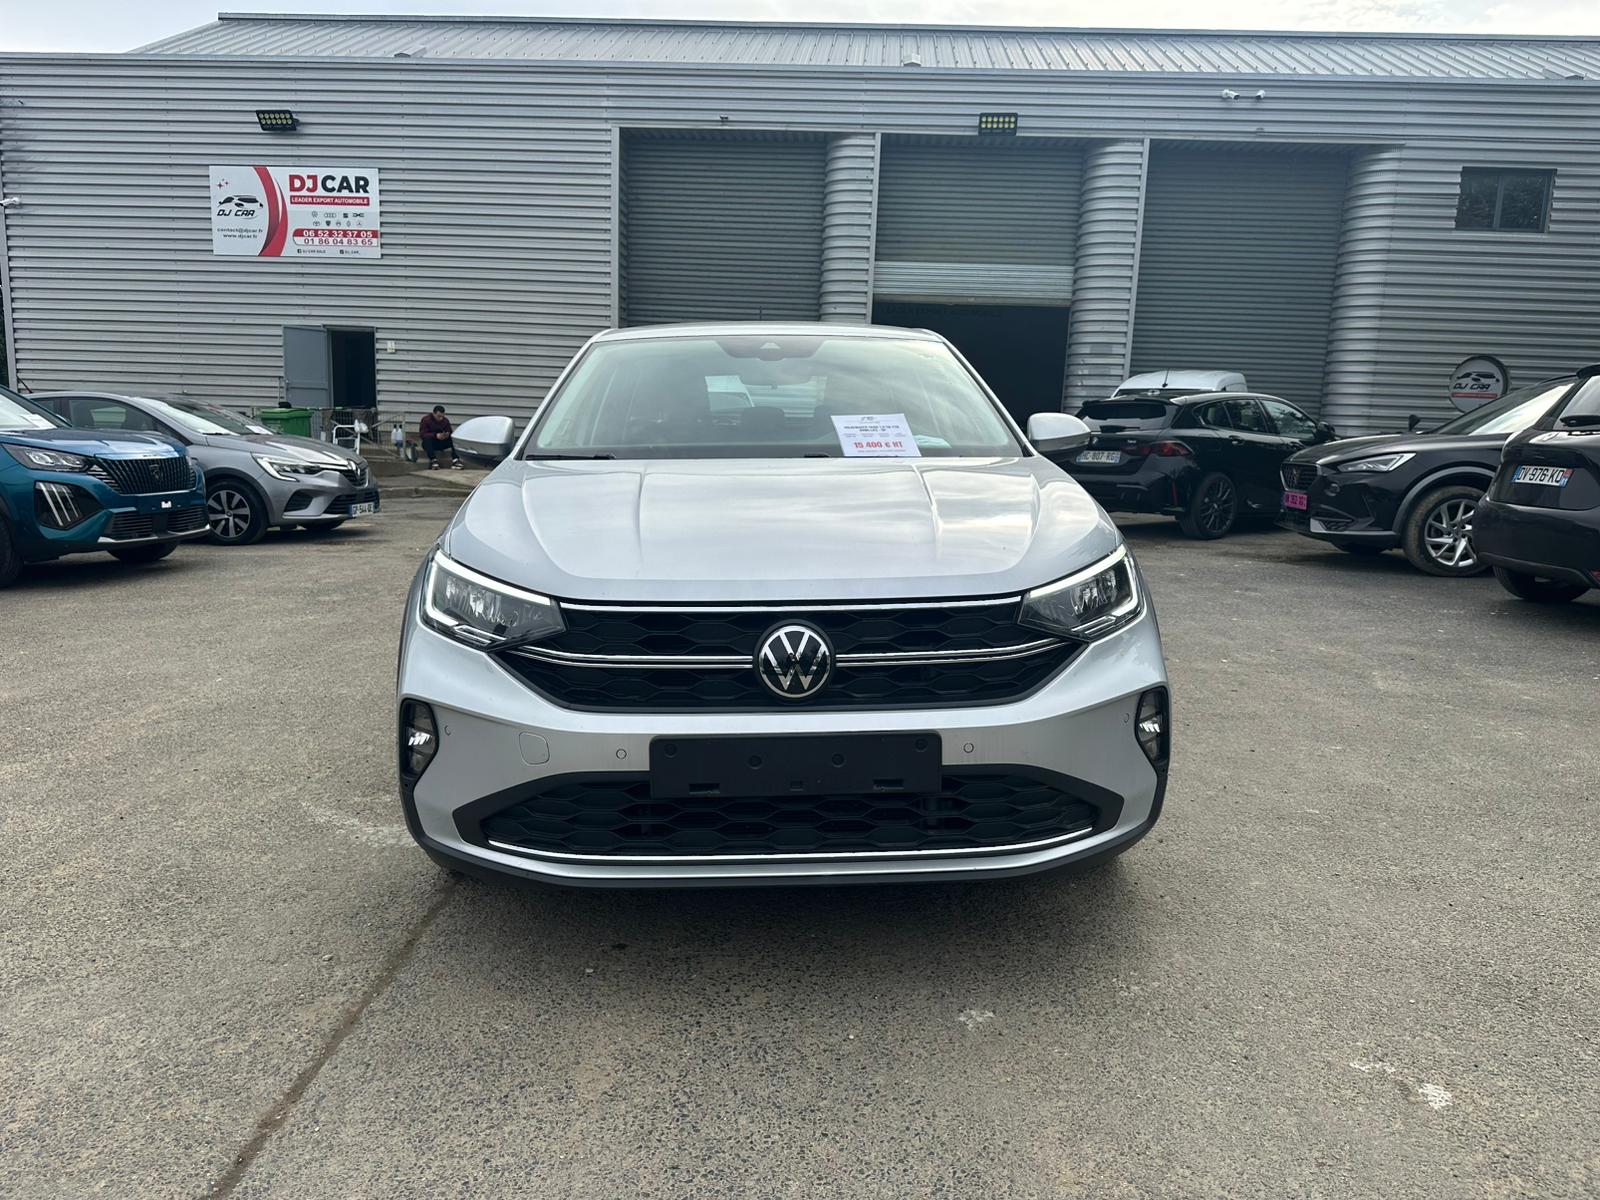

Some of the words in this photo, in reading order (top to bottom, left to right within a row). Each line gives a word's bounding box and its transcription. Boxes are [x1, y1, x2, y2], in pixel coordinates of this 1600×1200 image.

[288, 174, 318, 193] DJ
[321, 174, 370, 194] CAR
[216, 209, 232, 217] DJ
[234, 209, 256, 217] CAR
[317, 230, 330, 238] 52
[331, 230, 344, 238] 32
[318, 238, 330, 246] 86
[332, 238, 344, 246] 04
[346, 238, 359, 246] 83
